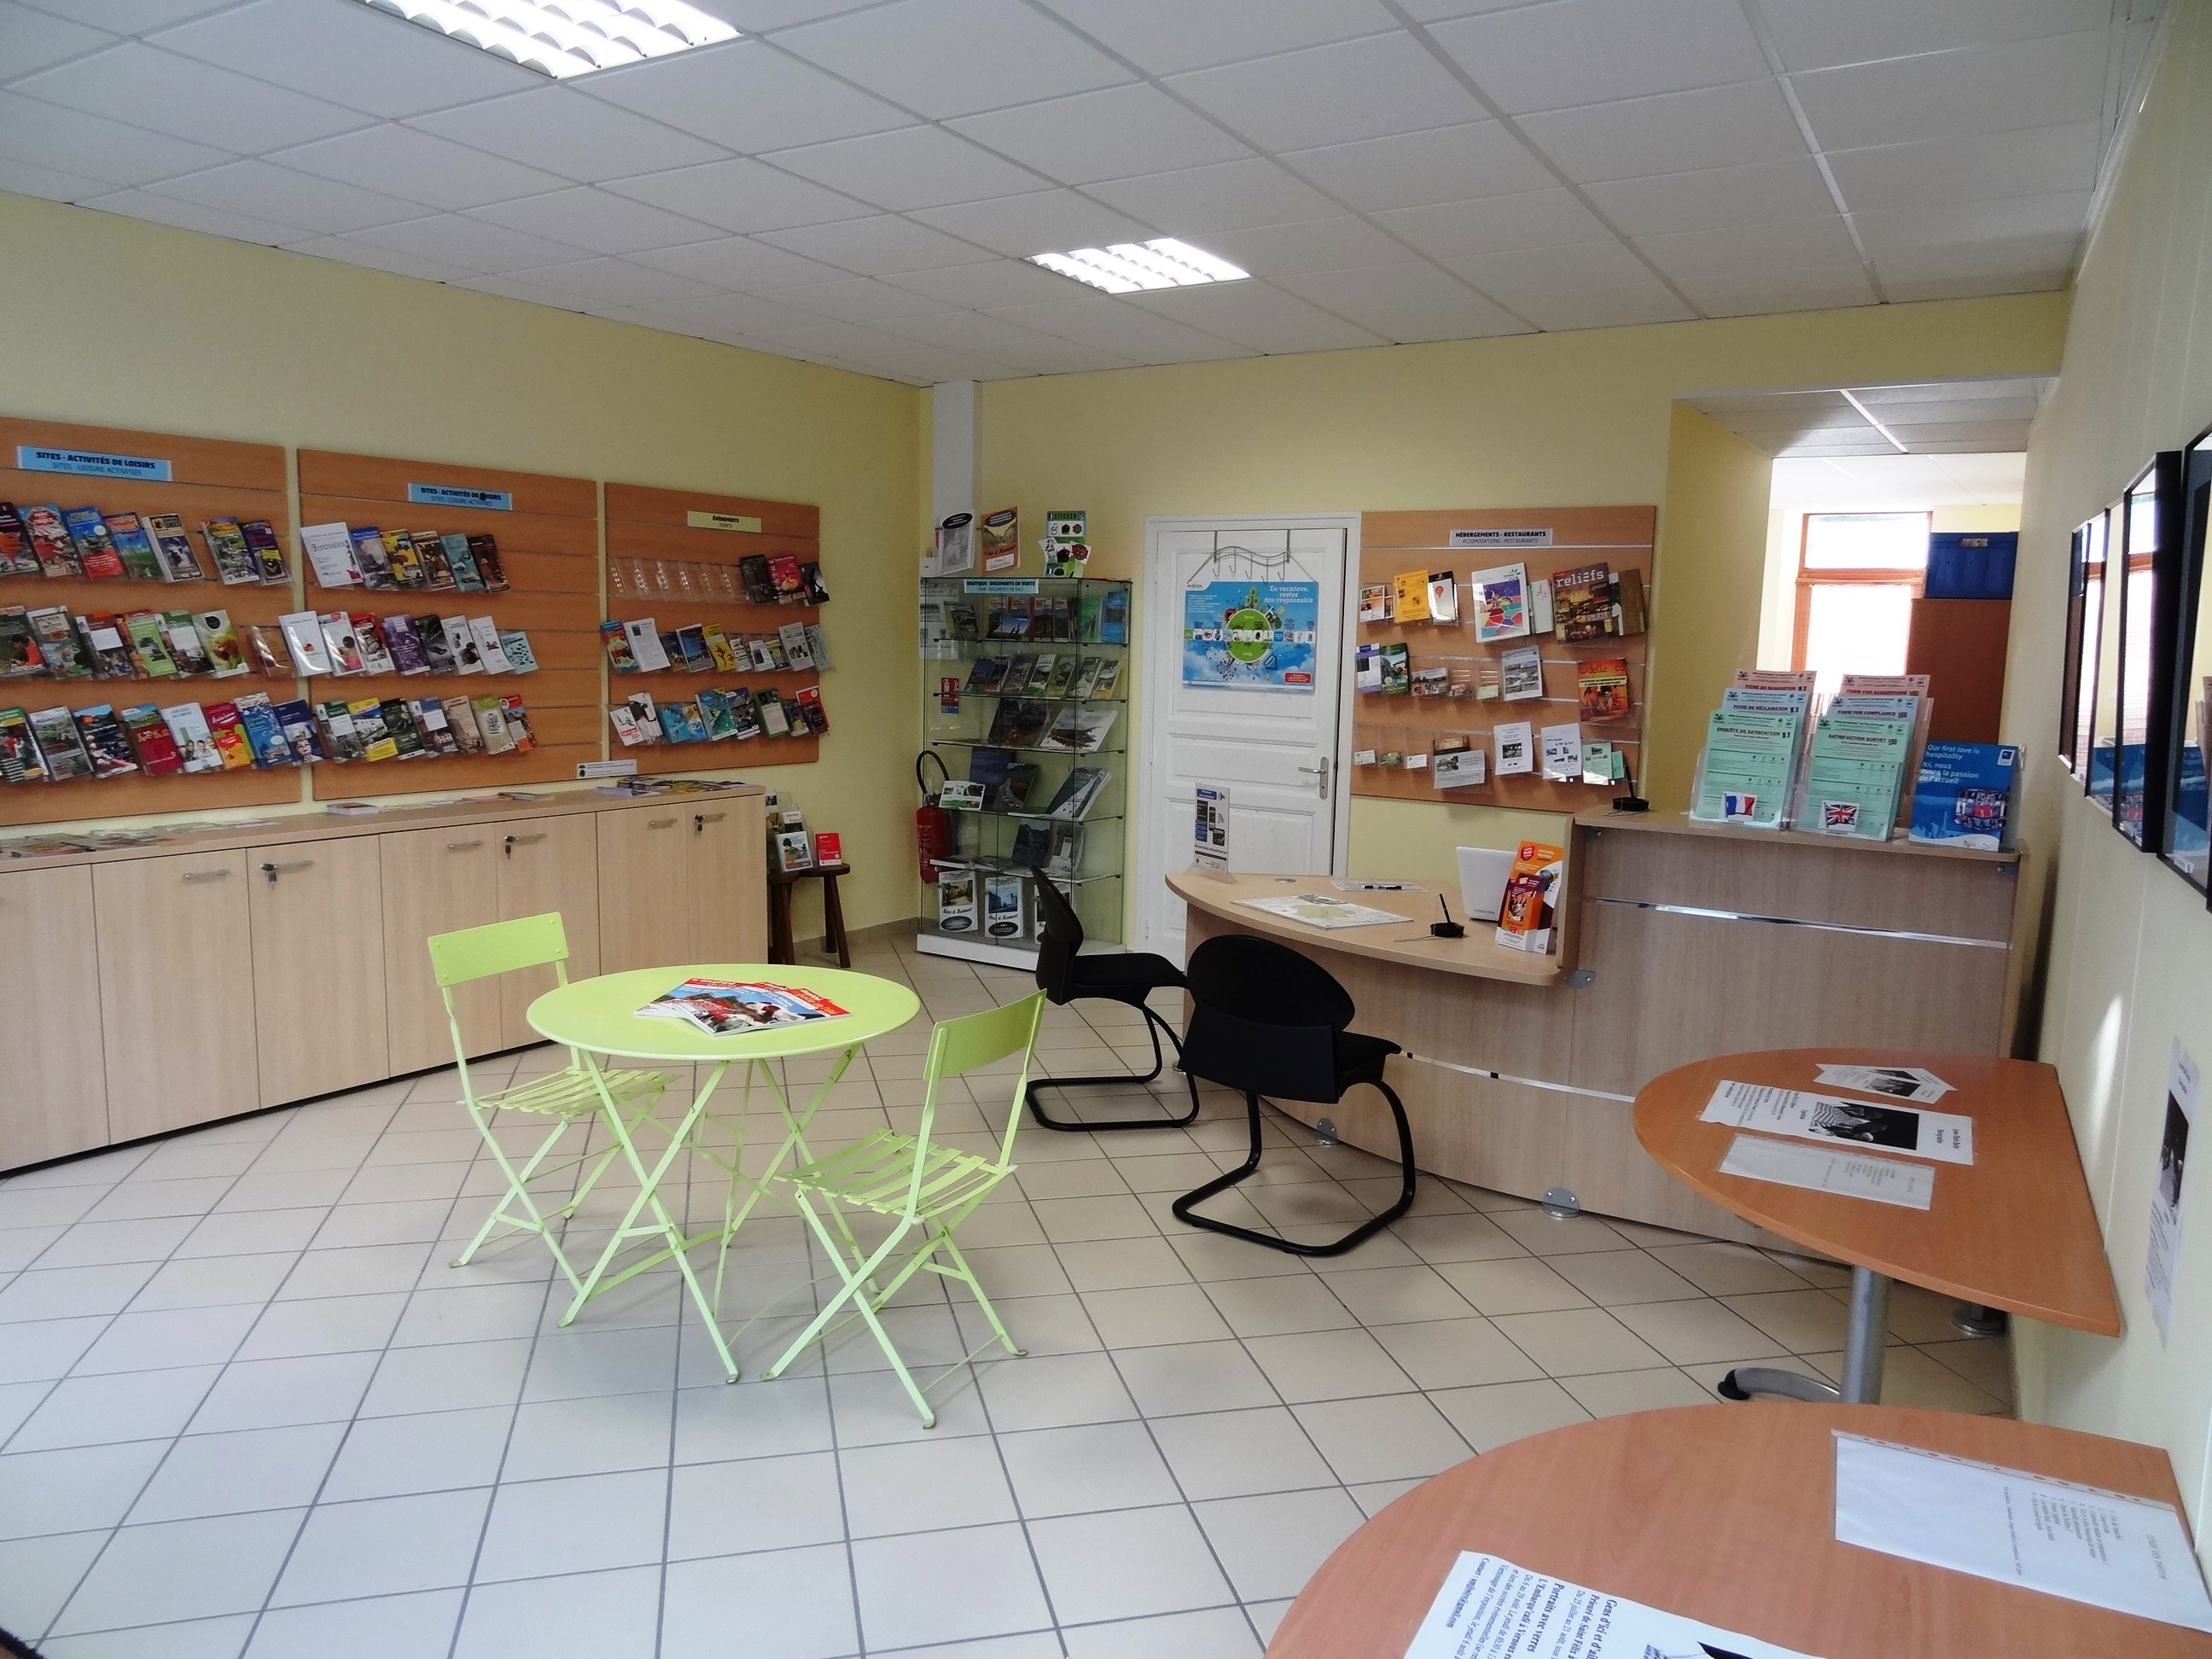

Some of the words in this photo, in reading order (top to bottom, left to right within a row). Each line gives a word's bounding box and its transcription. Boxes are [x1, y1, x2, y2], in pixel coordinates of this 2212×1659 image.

[36, 451, 61, 460] SITES
[67, 454, 110, 465] ACTIVITÉS
[124, 459, 155, 469] LOISIRS
[1556, 569, 1604, 588] reliefs
[1925, 751, 1963, 760] hospitality
[1476, 1558, 1489, 1575] Contact
[1545, 1583, 1563, 1612] Portraits
[1585, 1594, 1599, 1615] Prieuré
[1603, 1599, 1617, 1616] Gens
[1537, 1613, 1549, 1629] avec
[1597, 1617, 1610, 1634] d'ici
[1575, 1623, 1588, 1639] Saint
[1593, 1633, 1603, 1642] et
[1507, 1629, 1525, 1653] Vernoux
[1527, 1631, 1542, 1652] verres
[1569, 1639, 1583, 1654] Félix
